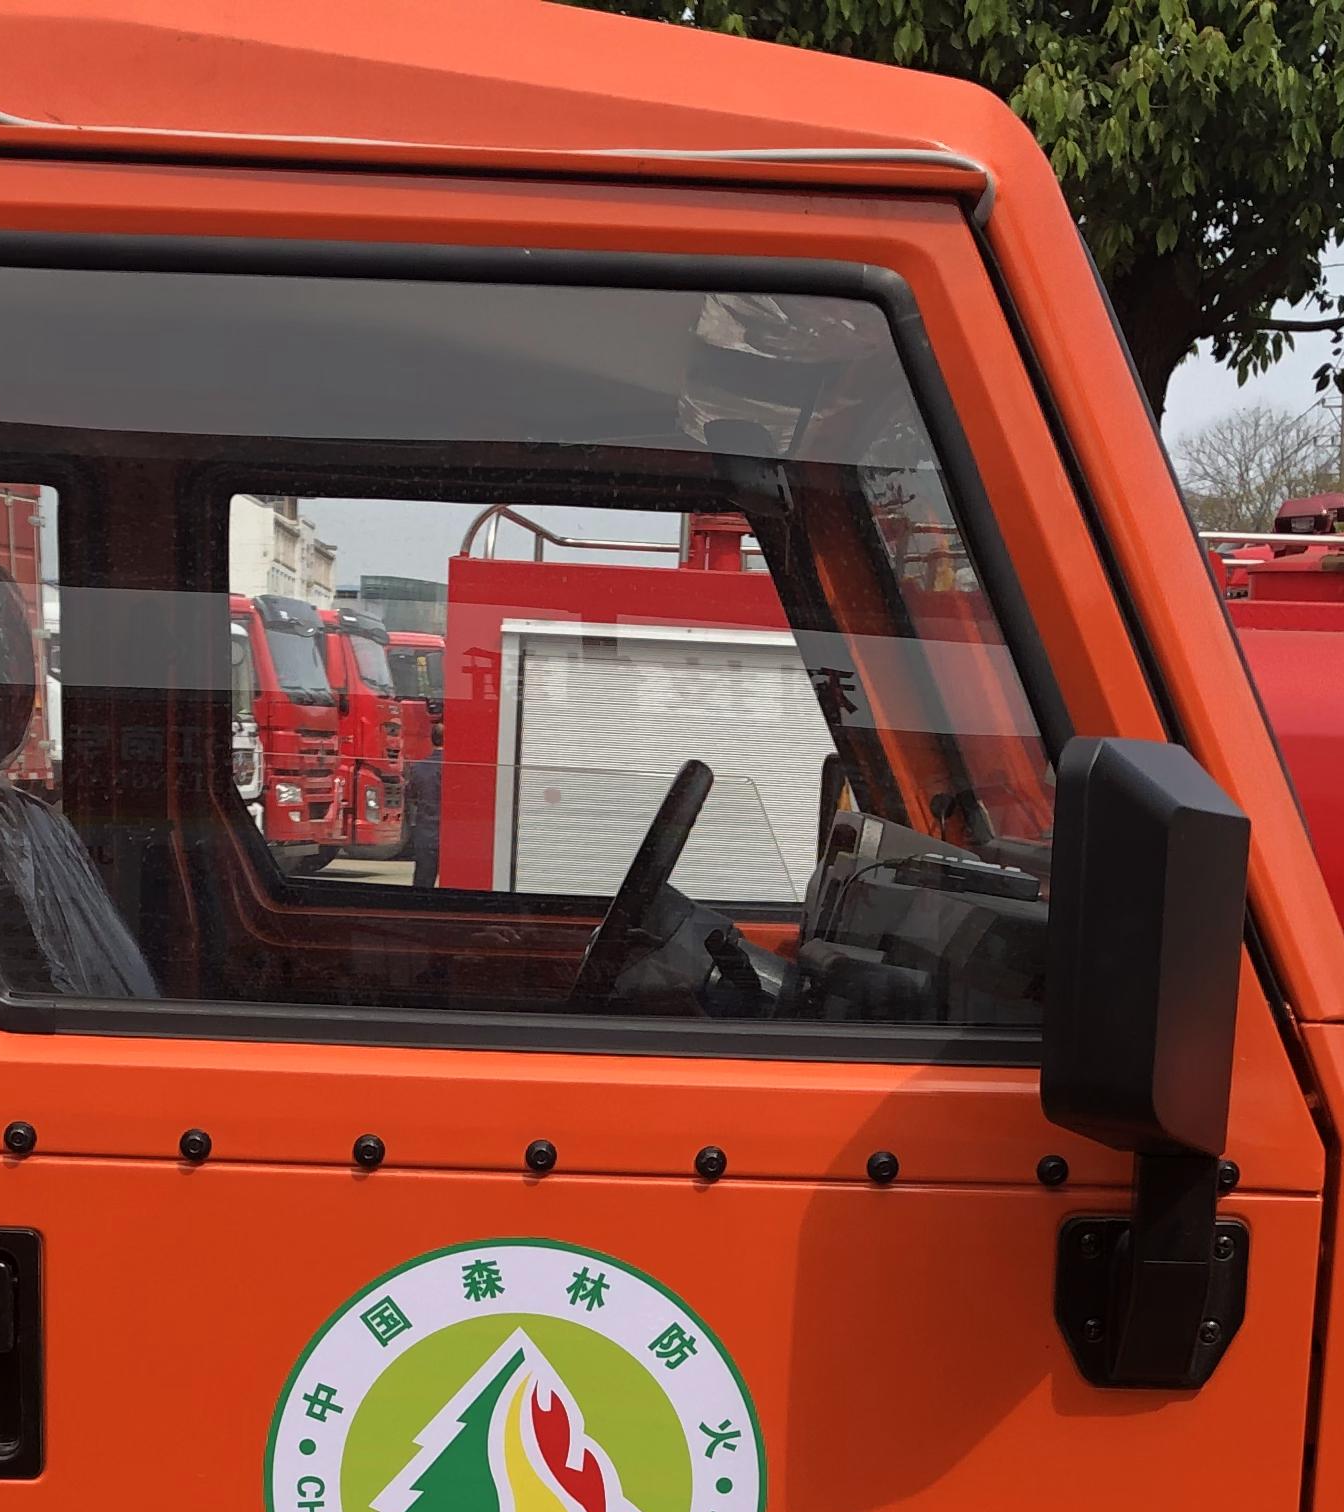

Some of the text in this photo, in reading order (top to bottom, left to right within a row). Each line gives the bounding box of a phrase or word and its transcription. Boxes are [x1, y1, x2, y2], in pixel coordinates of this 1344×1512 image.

[301, 1258, 743, 1460] 中国森林防火
